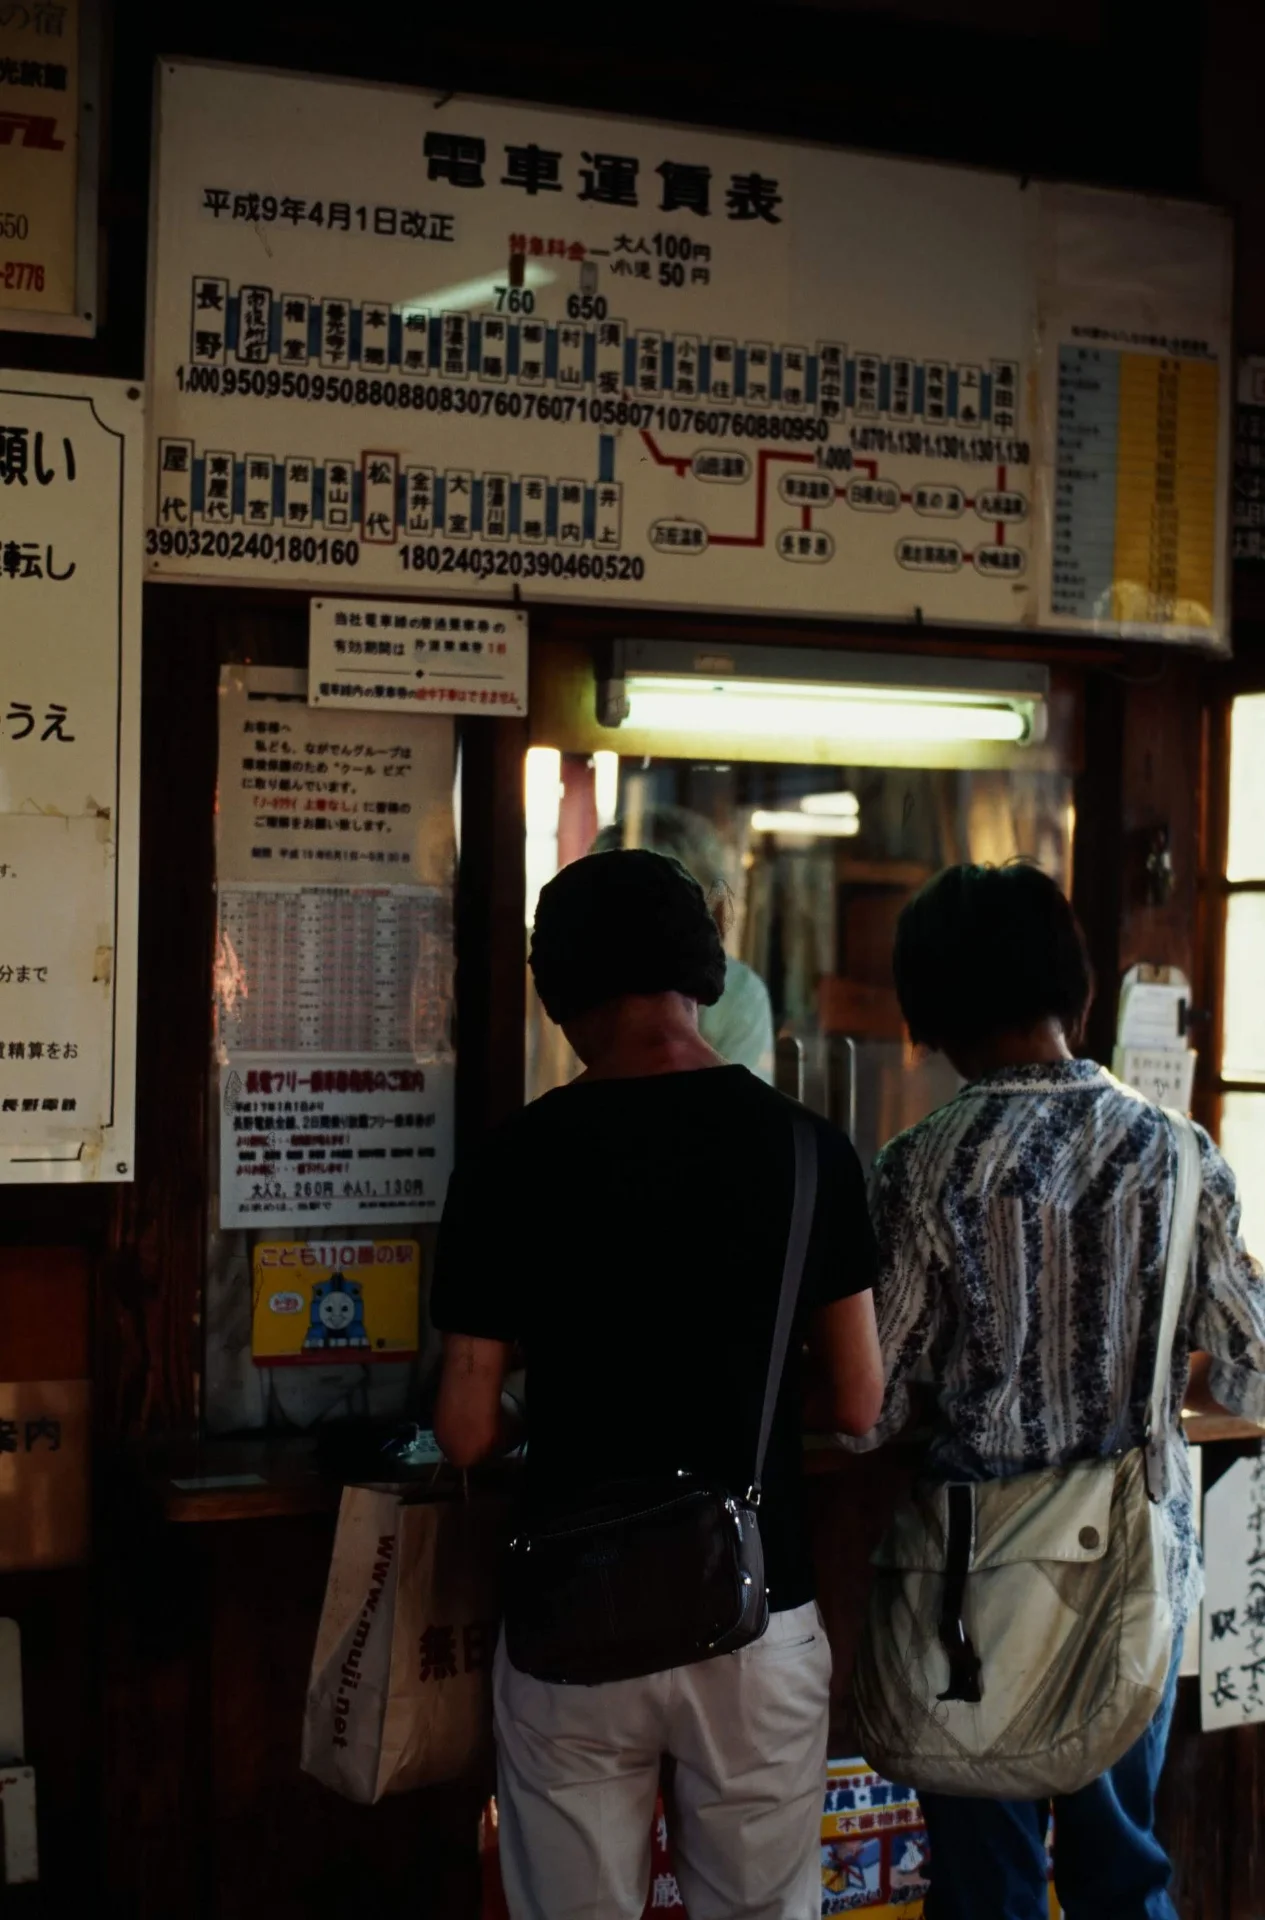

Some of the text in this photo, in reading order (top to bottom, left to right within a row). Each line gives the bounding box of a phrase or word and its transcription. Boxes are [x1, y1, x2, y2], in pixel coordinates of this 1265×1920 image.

[423, 132, 783, 224] 電車運賃表
[203, 188, 455, 242] 平成9年4月1日改正
[613, 233, 711, 262] 大人100円
[196, 283, 223, 359] 長野
[495, 286, 534, 314] 760
[567, 294, 607, 320] 650
[560, 329, 580, 384] 村山
[598, 324, 620, 395] 須坂
[223, 368, 267, 395] 950
[267, 370, 309, 398] 950
[312, 375, 353, 403] 950
[354, 379, 396, 407] 880
[397, 382, 440, 411] 880
[440, 387, 480, 413] 830
[480, 391, 521, 417] 760
[522, 394, 562, 420] 760
[563, 397, 602, 422] 710
[601, 400, 641, 427] 580
[641, 405, 680, 431] 710
[681, 409, 719, 434] 760
[719, 412, 755, 437] 760
[755, 416, 793, 439] 880
[793, 417, 828, 441] 950
[162, 446, 188, 522] 屋代
[207, 457, 229, 519] 東屋代
[248, 461, 269, 520] 雨宮
[289, 464, 309, 521] 岩野
[366, 461, 391, 537] 松代
[410, 472, 430, 530] 金井山
[449, 476, 469, 533] 大室
[598, 490, 617, 543] 井上
[0, 541, 75, 580] 転し
[146, 528, 359, 566] 390 320 240 180 160
[399, 545, 644, 580] 180 240 320 390 460 520
[6, 702, 75, 743] うえ
[262, 1245, 413, 1267] こども110番の駅
[332, 1535, 395, 1749] www.muji.net
